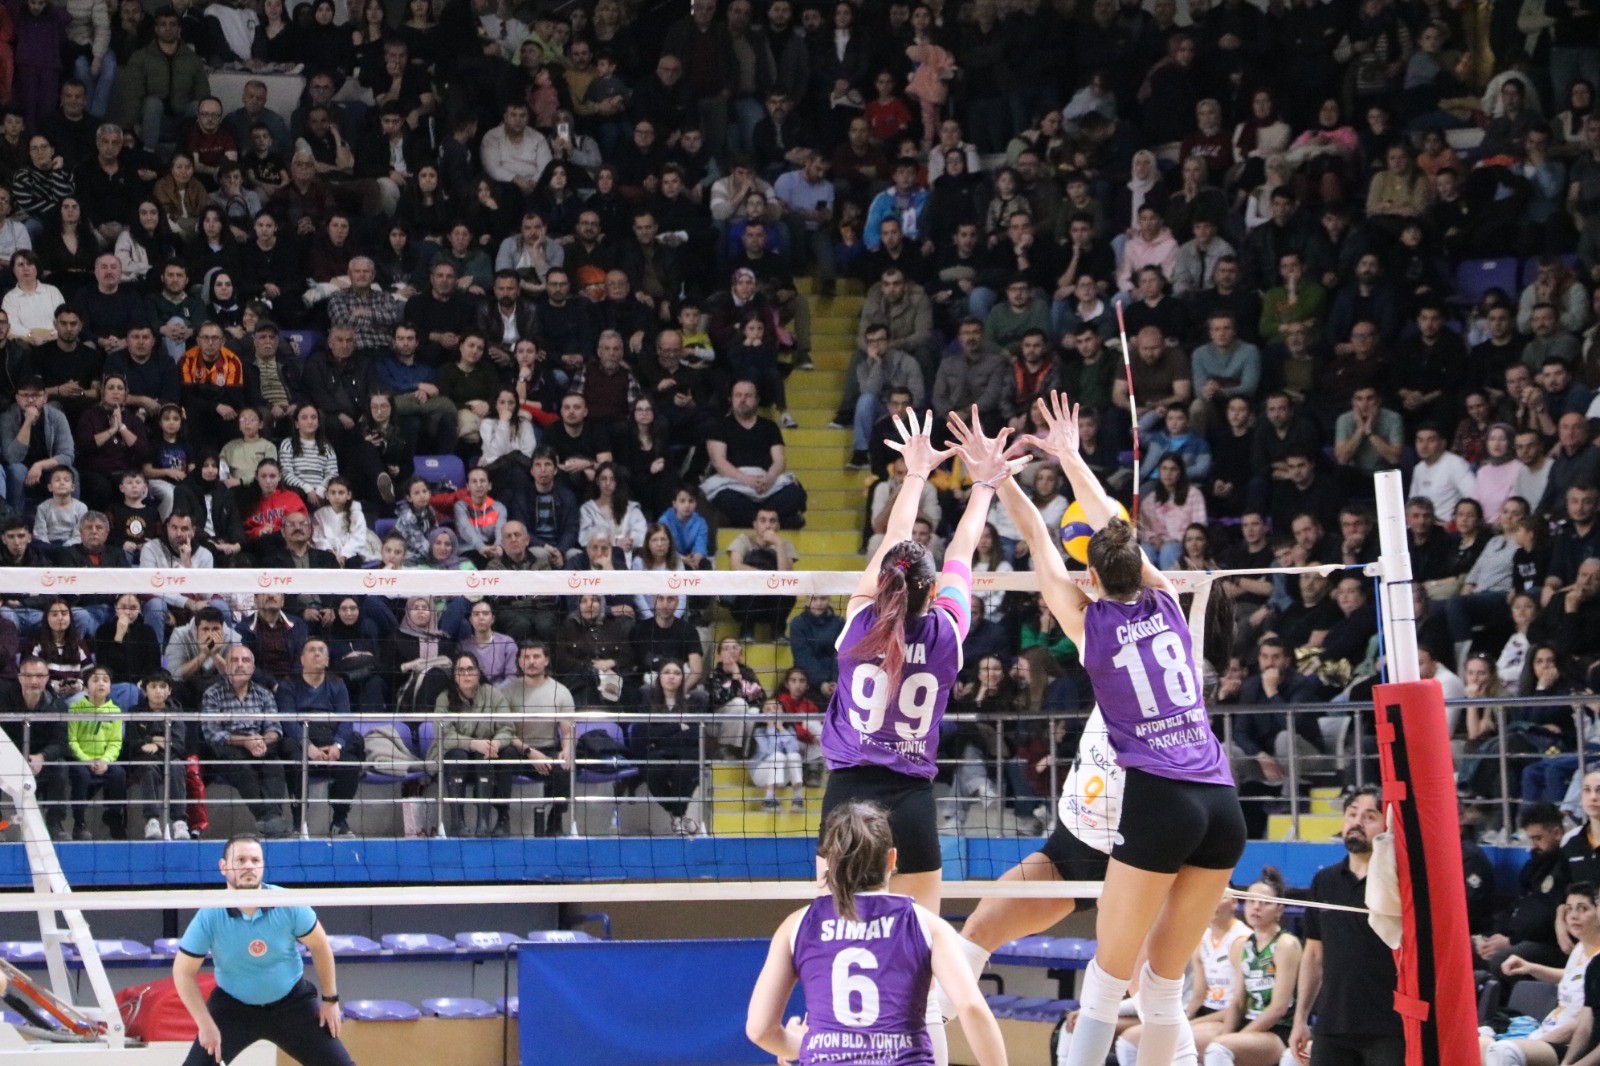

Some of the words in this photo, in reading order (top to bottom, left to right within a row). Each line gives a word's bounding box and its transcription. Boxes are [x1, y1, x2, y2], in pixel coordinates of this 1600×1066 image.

[57, 576, 77, 584] TVF
[167, 577, 186, 585] TVF
[273, 577, 292, 585] TVF
[378, 577, 397, 585] TVF
[482, 577, 500, 586] TVF
[583, 578, 601, 586] TVF
[683, 578, 700, 587] TVF
[781, 578, 799, 587] TVF
[1075, 578, 1091, 586] TVF
[1170, 578, 1186, 586] TVF
[1112, 631, 1197, 718] 18
[848, 663, 939, 741] 99
[1136, 720, 1165, 737] AFYON
[1084, 775, 1105, 805] 9
[820, 916, 894, 941] SIMAY
[832, 947, 880, 1028] 6
[807, 1033, 840, 1050] AFYON
[842, 1033, 866, 1048] BLD.
